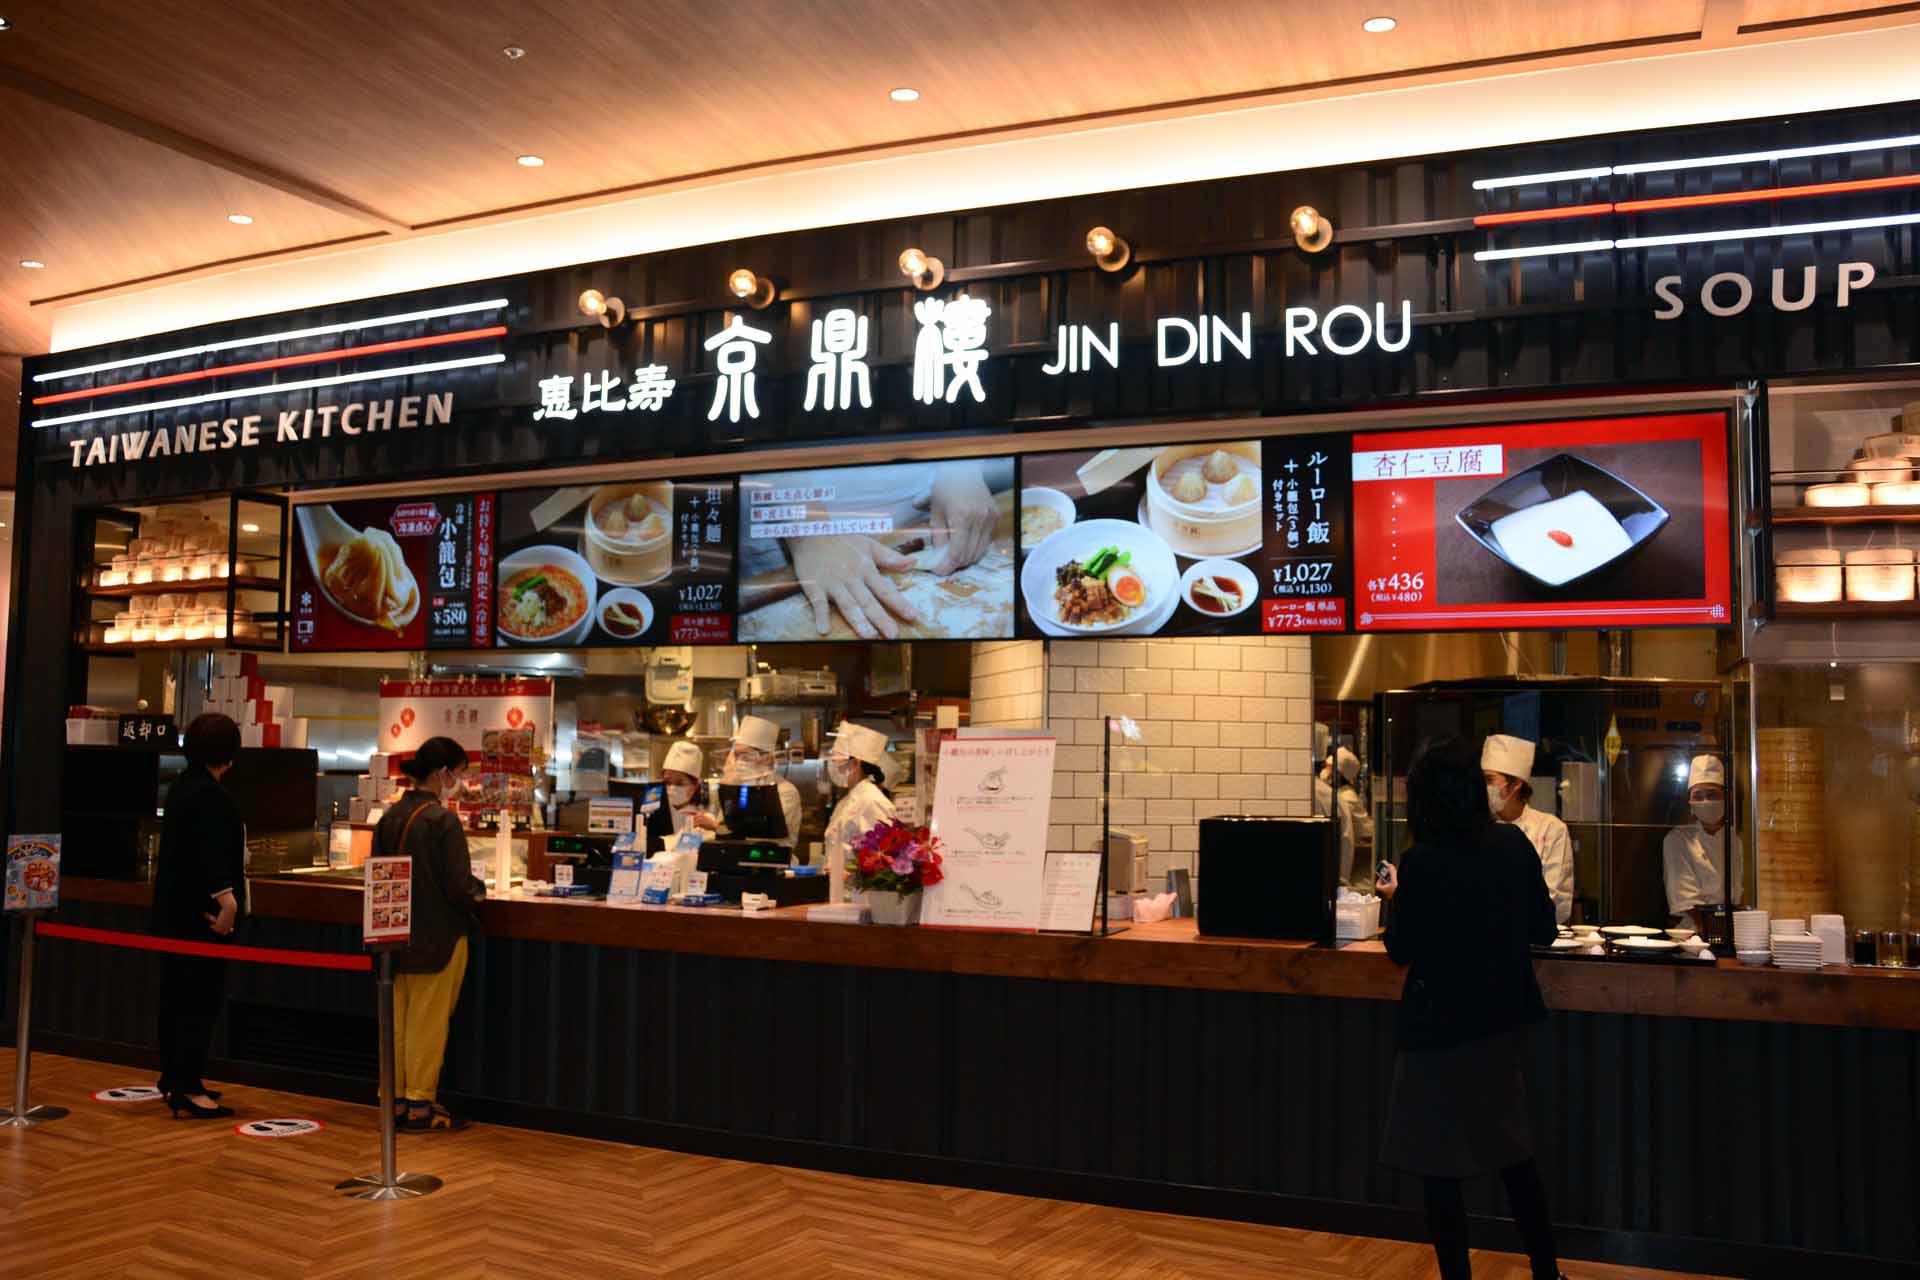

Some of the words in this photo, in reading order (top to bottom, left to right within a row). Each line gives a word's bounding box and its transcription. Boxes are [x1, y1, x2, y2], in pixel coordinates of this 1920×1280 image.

[1653, 261, 1876, 320] SOUP
[1041, 322, 1119, 376] JIN
[1157, 311, 1252, 367] DIN
[1285, 300, 1412, 357] ROU
[533, 362, 677, 422] 恵比寿
[71, 414, 260, 467] TAIWANESE
[276, 391, 454, 441] KITCHEN
[1373, 450, 1483, 477] 杏仁豆腐
[1307, 451, 1330, 543] ルーロー飯
[1272, 563, 1333, 584] ¥1,027
[433, 608, 467, 625] ¥580
[123, 719, 167, 742] 返却口
